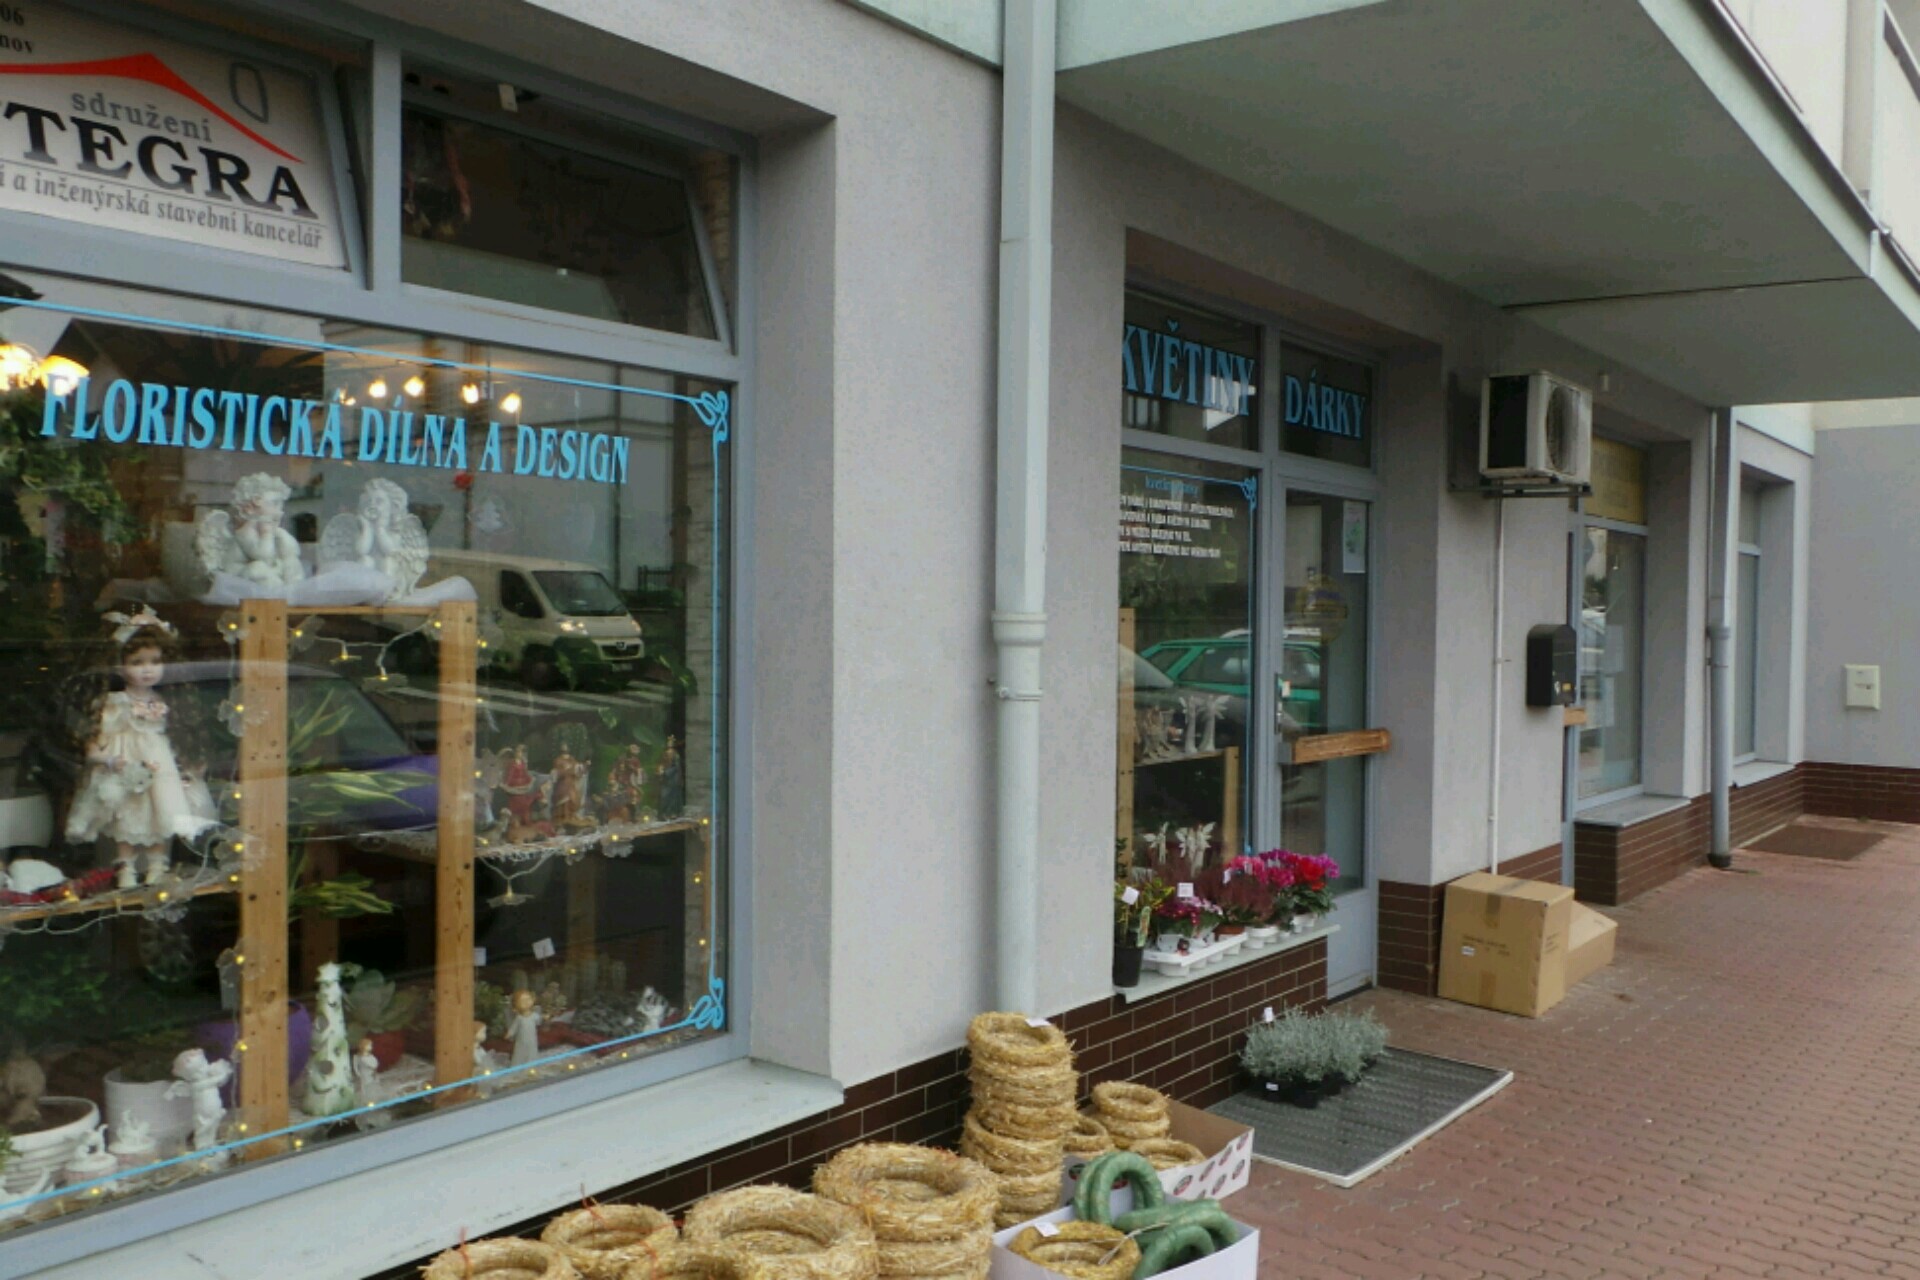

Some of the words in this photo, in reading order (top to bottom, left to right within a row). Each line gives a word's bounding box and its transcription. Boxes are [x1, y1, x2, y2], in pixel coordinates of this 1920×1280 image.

[4, 102, 319, 220] TEGRA
[71, 92, 213, 143] sdružení
[13, 174, 26, 191] a
[35, 170, 149, 217] inženýrská
[156, 197, 237, 233] stavební
[243, 209, 322, 249] kancelář
[40, 374, 344, 460] FLORISTICKÁ
[357, 394, 467, 470] DÍLNA
[479, 420, 502, 473] A
[513, 424, 631, 484] DESIGN
[1122, 318, 1255, 417] KVĚTINY
[1284, 368, 1366, 439] DÁRKY
